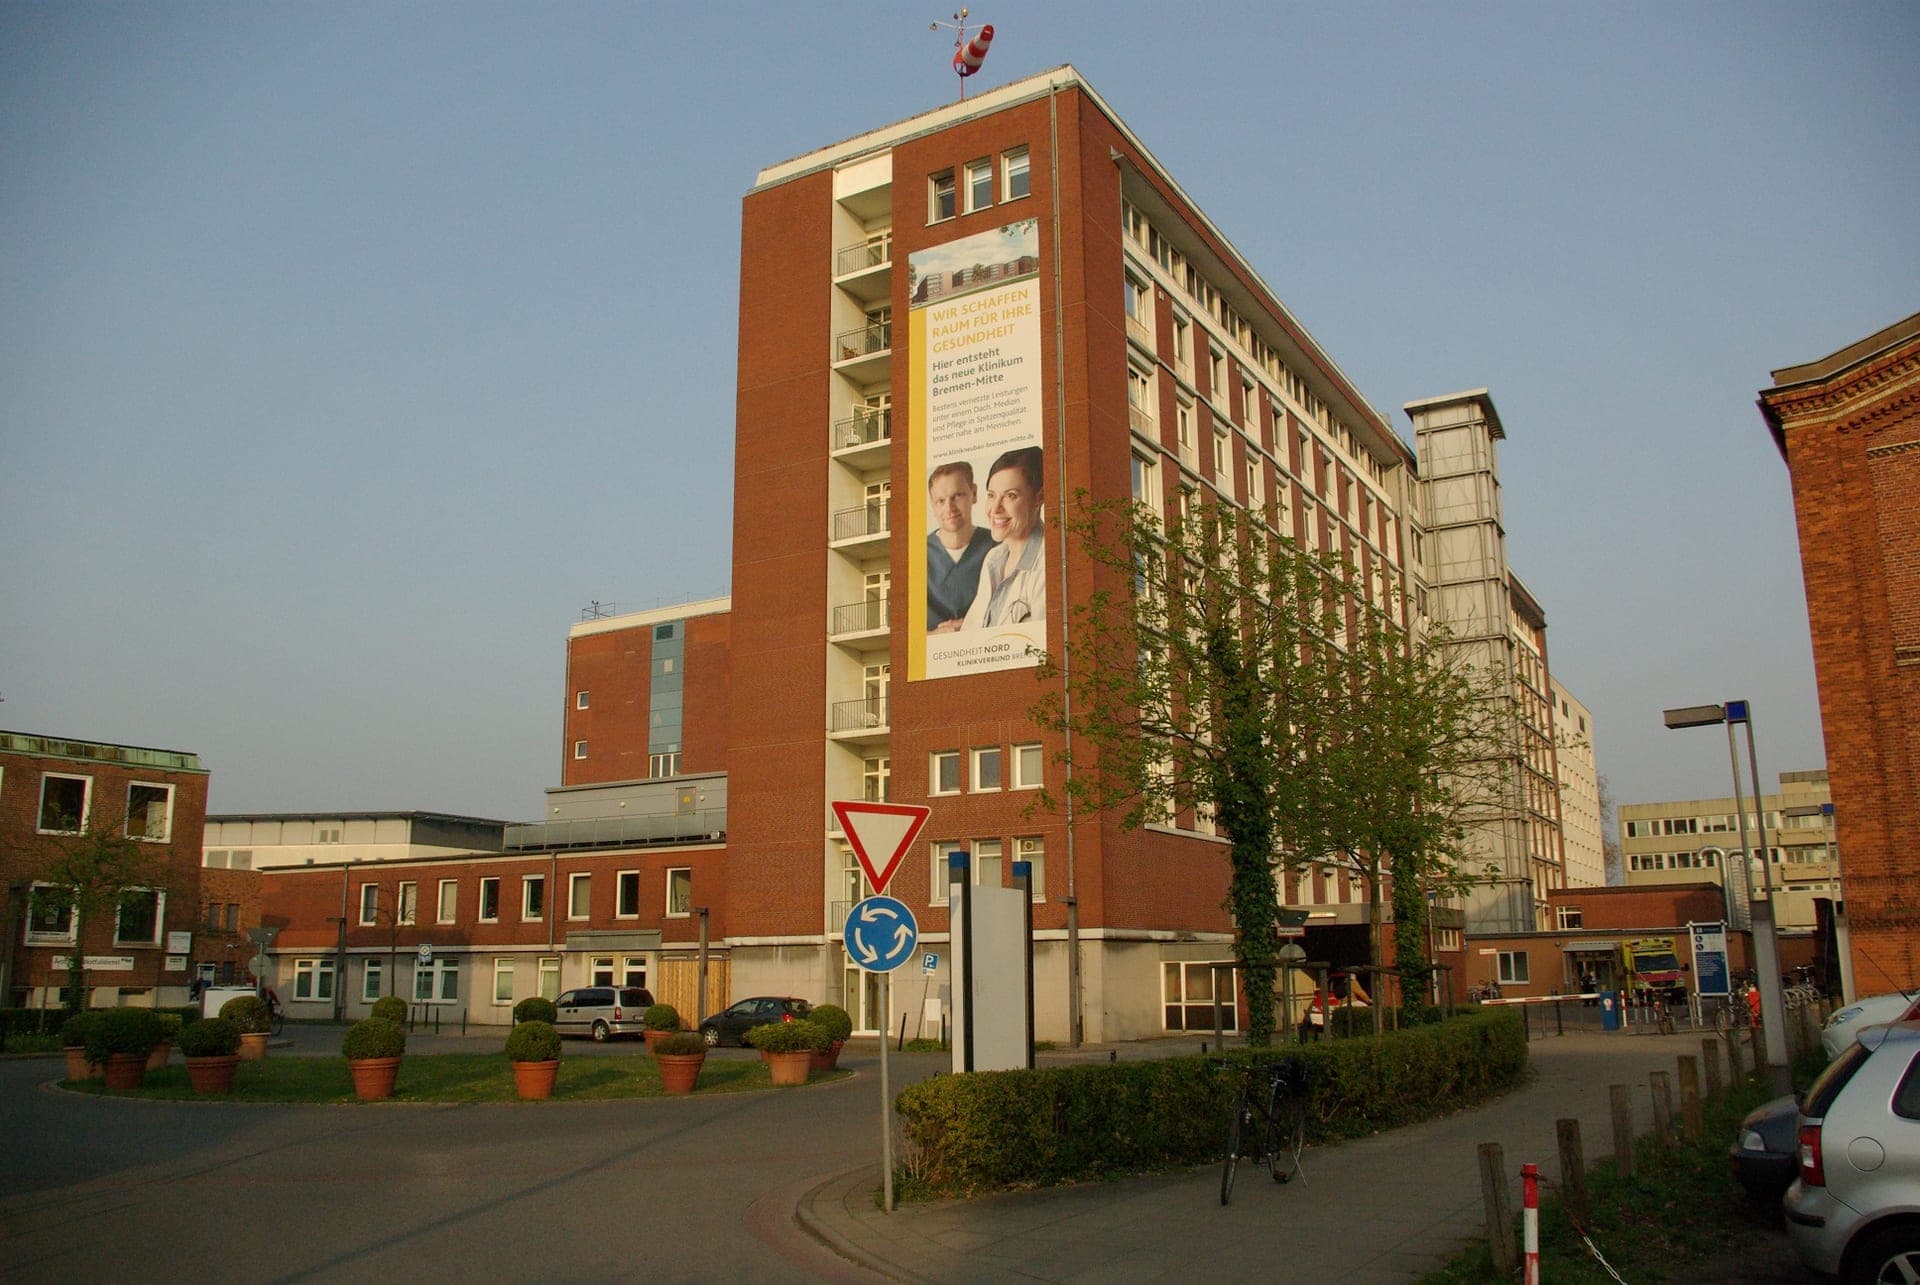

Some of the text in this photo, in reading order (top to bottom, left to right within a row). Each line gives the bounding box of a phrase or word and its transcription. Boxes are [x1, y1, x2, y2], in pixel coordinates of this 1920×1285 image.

[933, 289, 1028, 322] WIR SCHAFFEN
[932, 304, 1033, 338] RAUM FÜR IHRE
[932, 323, 1016, 353] GESUNDHEIT
[932, 348, 1000, 371] Hier entsteht
[932, 356, 1024, 384] das neue Klinikum
[932, 373, 1004, 397] Bremen-Mitte
[932, 643, 1010, 661] GESUNDHEIT NORD
[957, 654, 1010, 667] KLINIKVERBUND
[924, 954, 934, 966] P
